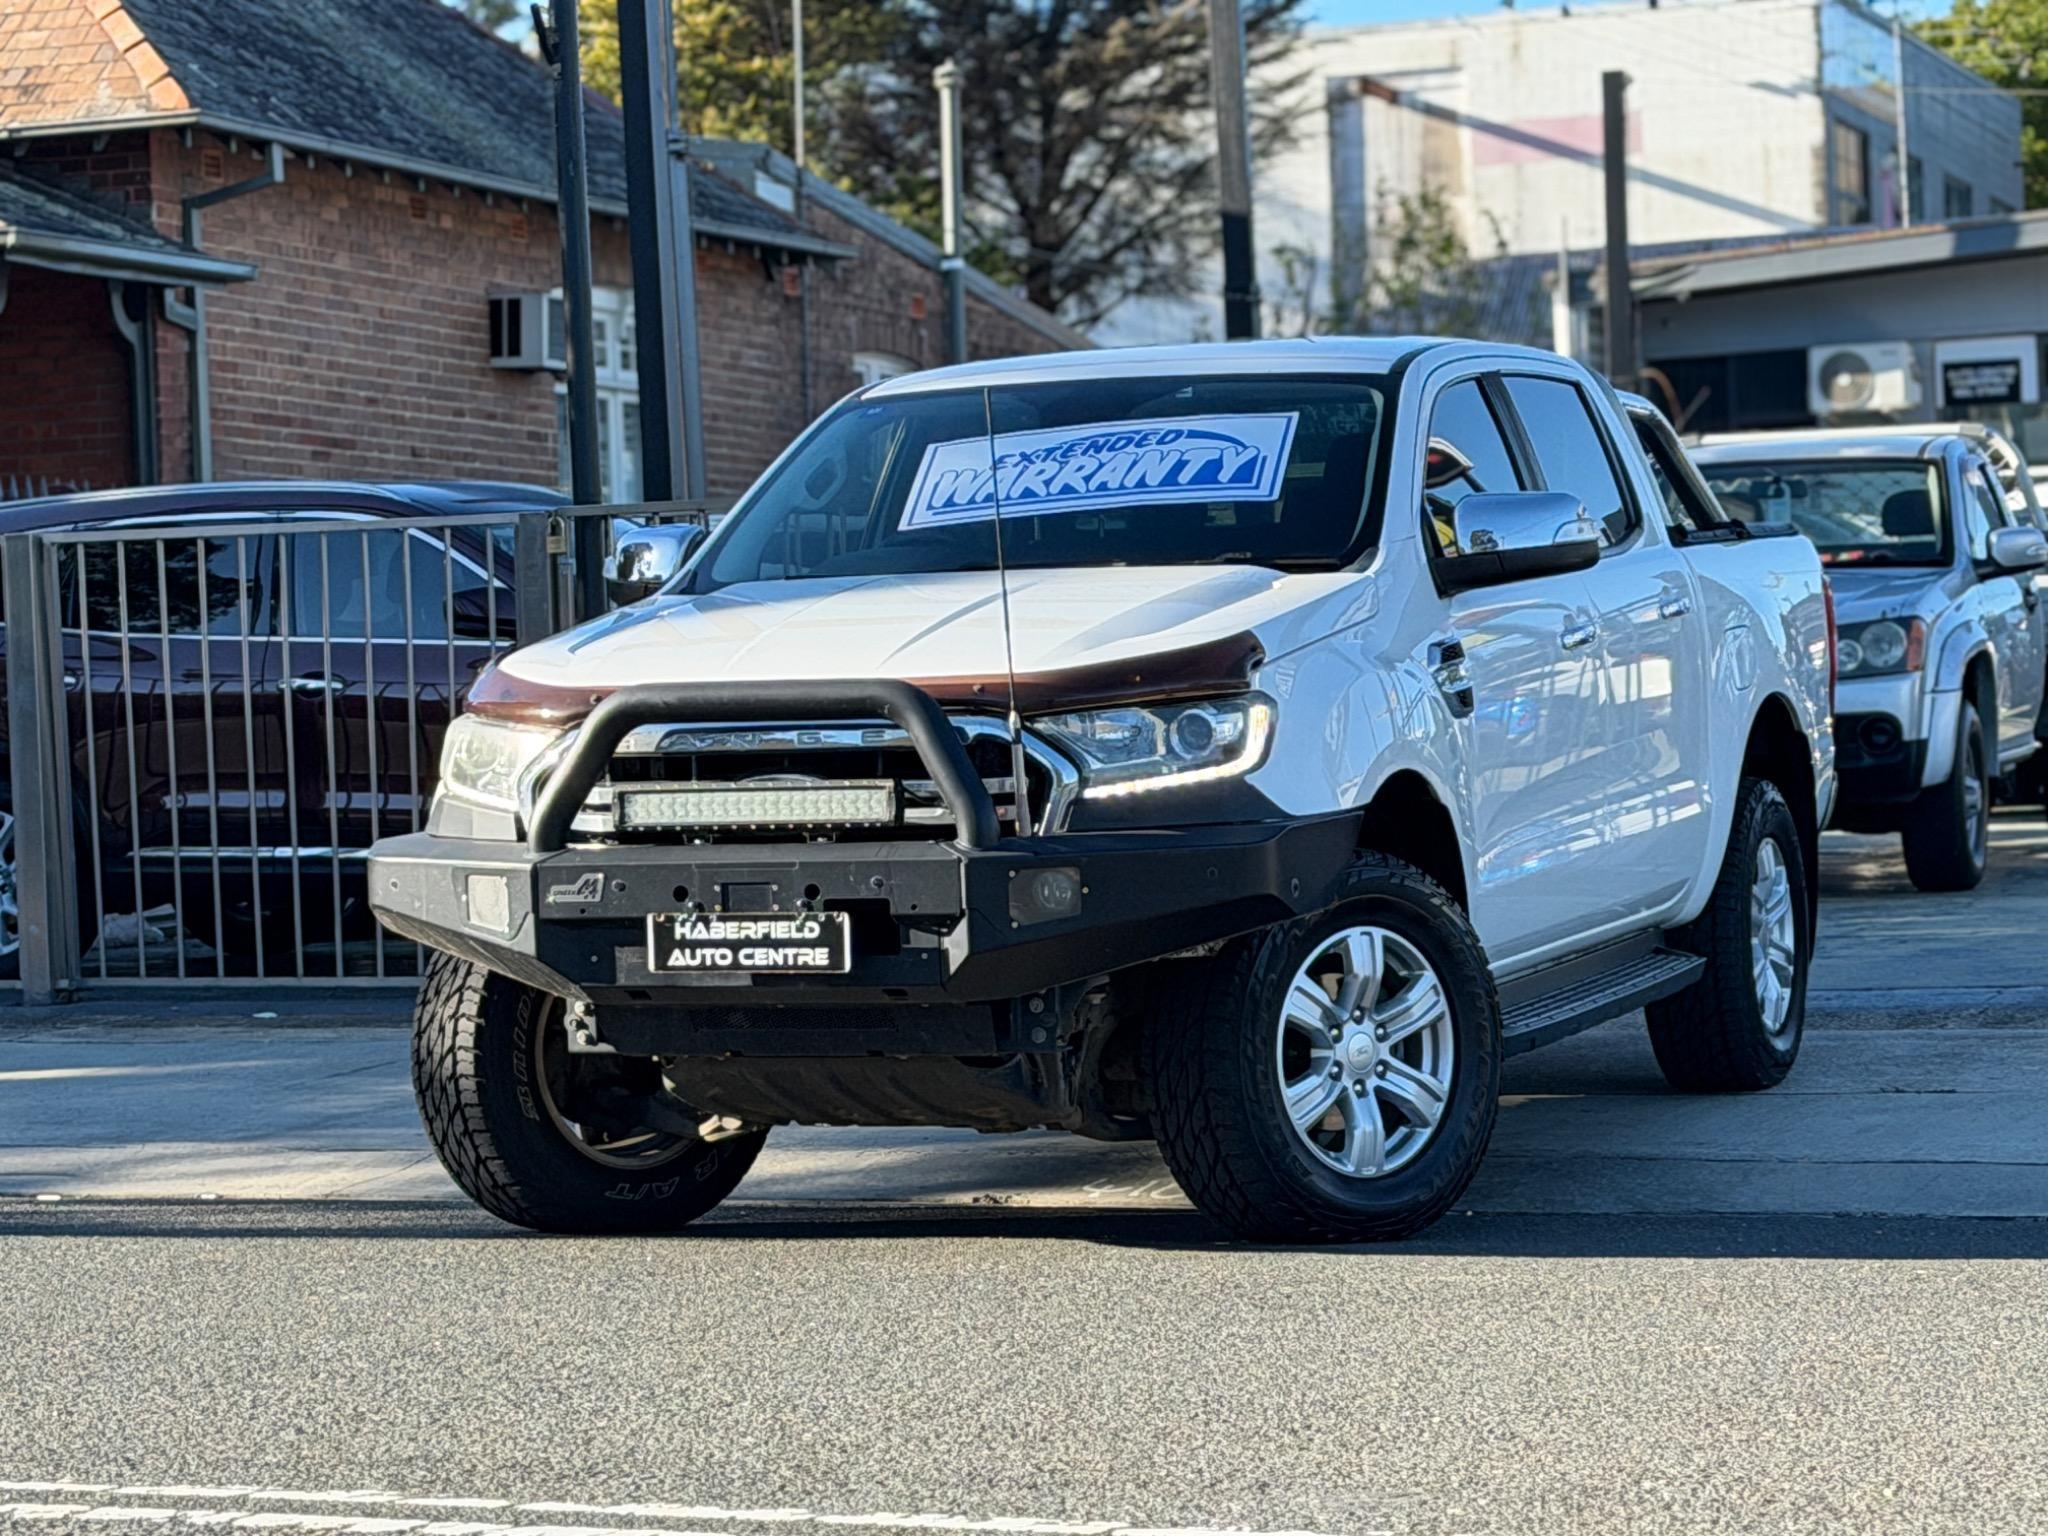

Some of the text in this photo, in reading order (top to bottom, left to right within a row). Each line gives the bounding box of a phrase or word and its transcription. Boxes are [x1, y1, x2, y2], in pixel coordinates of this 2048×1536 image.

[990, 428, 1187, 471] EXTENDED
[932, 445, 1261, 508] WARRANTY
[674, 921, 821, 941] HABERFIELD
[667, 947, 830, 966] AUTO CENTRE
